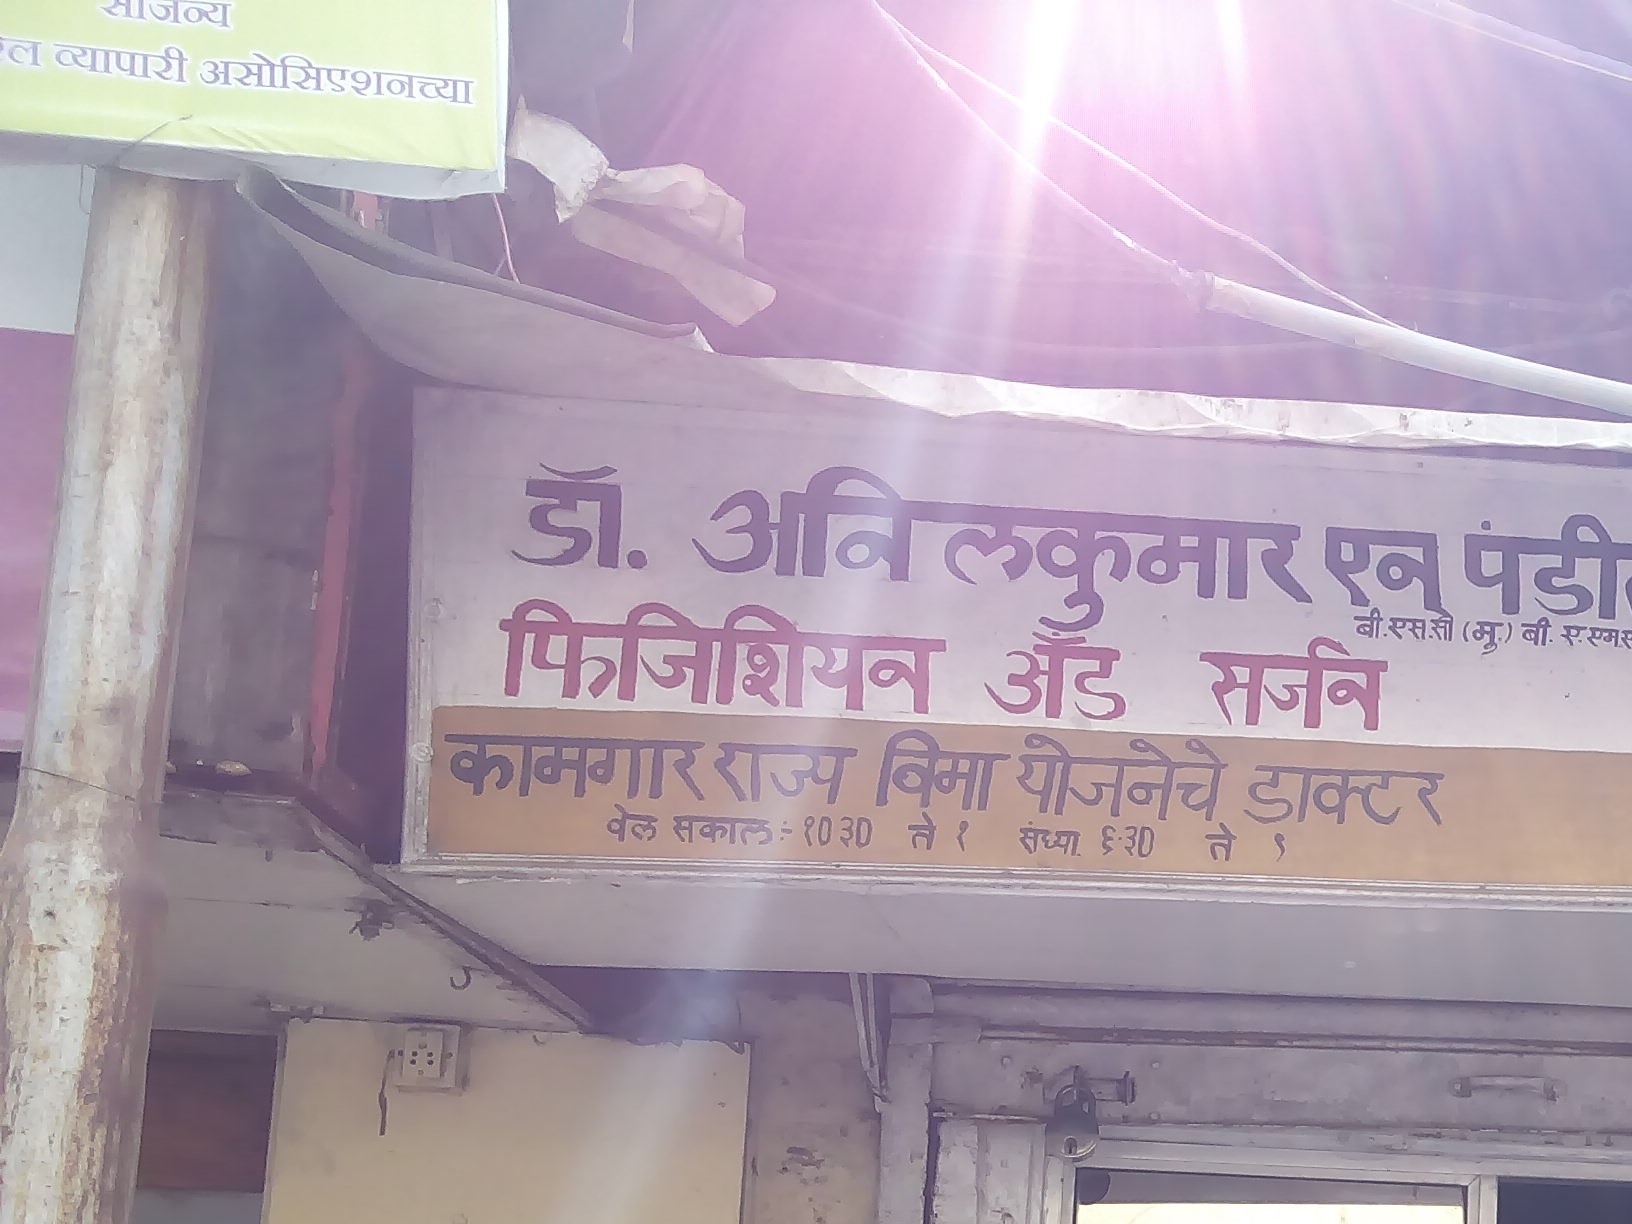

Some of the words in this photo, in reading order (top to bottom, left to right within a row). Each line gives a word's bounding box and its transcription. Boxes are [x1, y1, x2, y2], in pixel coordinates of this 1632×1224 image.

[0, 36, 42, 67] ल
[53, 43, 188, 83] व्यापारी
[200, 53, 474, 105] असोसिएशनच्या
[500, 598, 946, 713] फिजिशियन
[445, 733, 705, 800] कामगार
[876, 729, 1010, 811] विमा
[1017, 734, 1228, 821] योजनेचे
[908, 811, 937, 851] ते
[1205, 822, 1237, 861] ते
